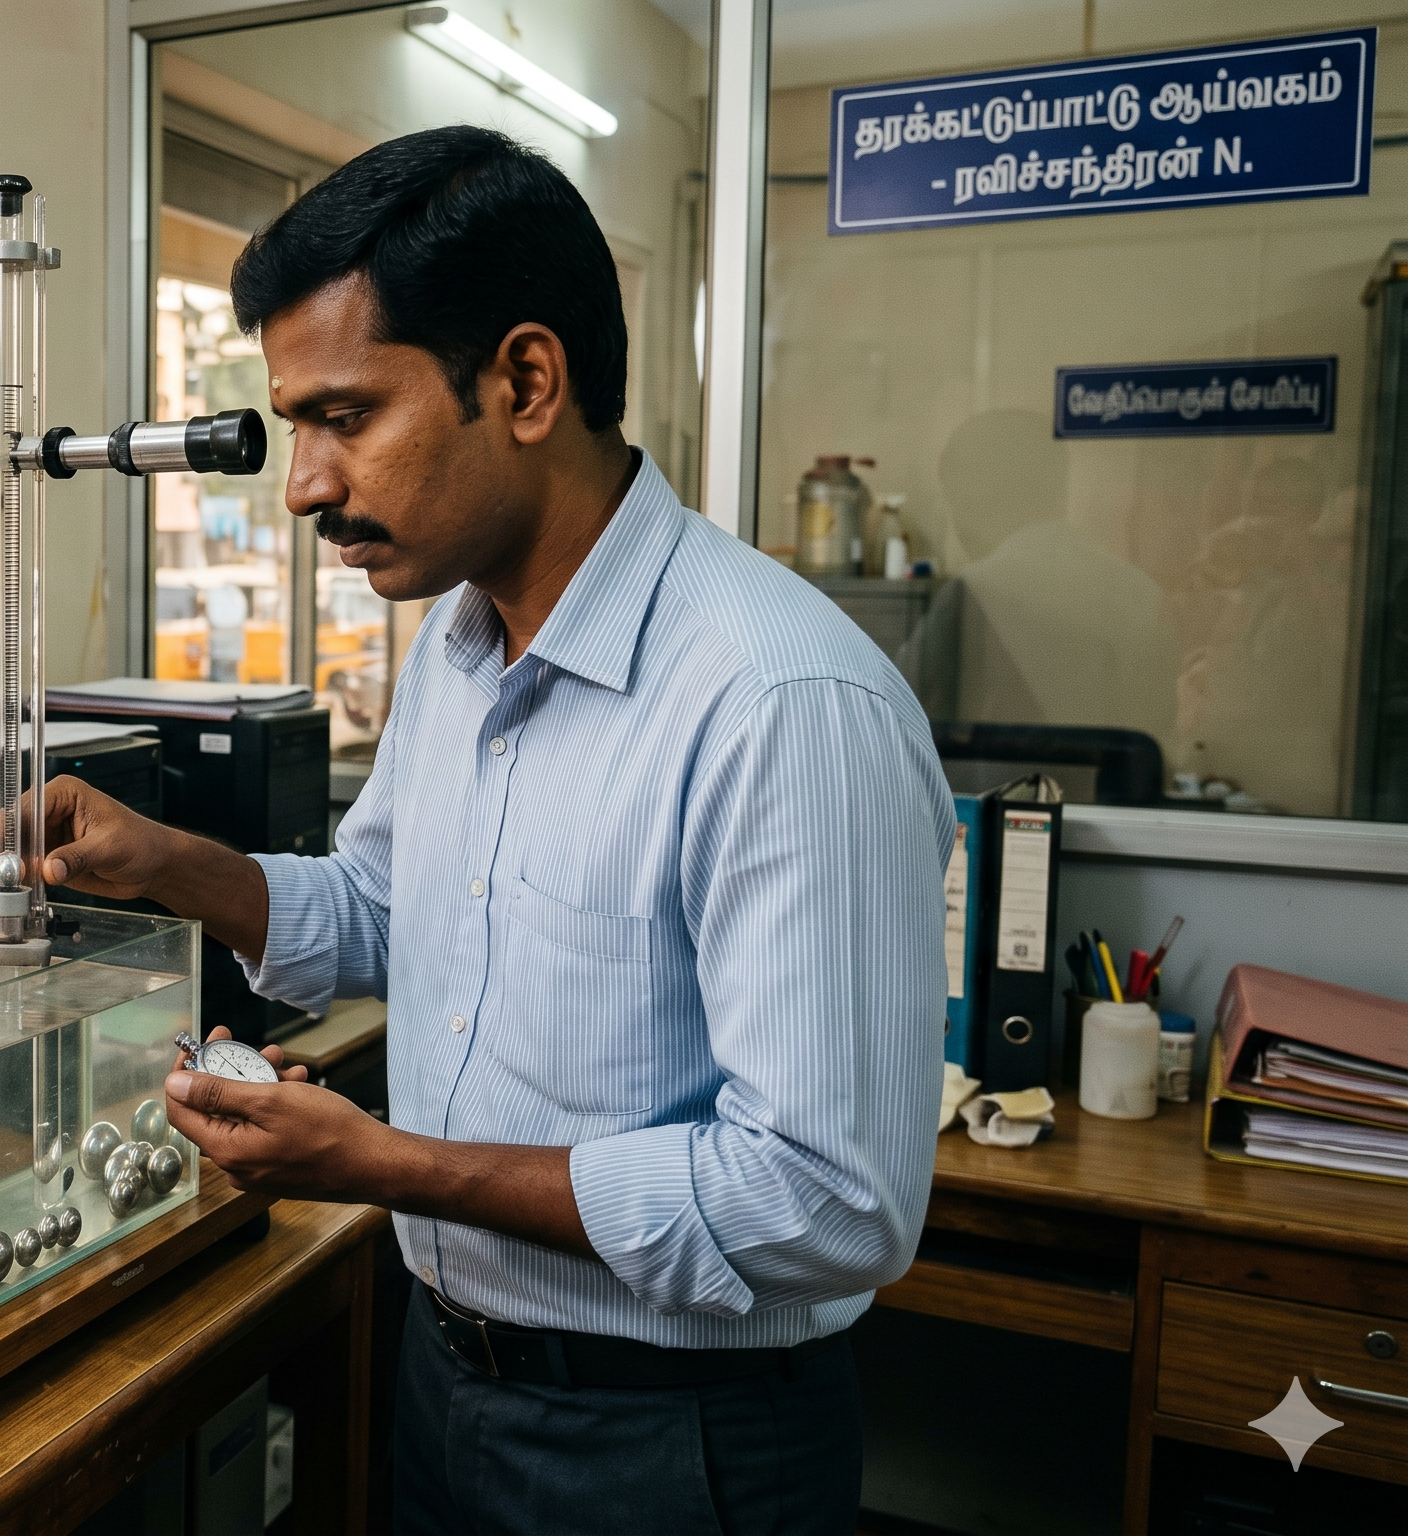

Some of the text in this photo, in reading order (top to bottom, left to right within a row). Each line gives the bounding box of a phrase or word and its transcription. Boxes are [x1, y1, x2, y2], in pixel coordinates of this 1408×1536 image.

[854, 57, 1343, 161] தரக்கட்டுப்பாட்டு ஆய்வகம்
[953, 135, 1203, 206] ரவிச்சந்திரன்
[1213, 136, 1254, 176] N.
